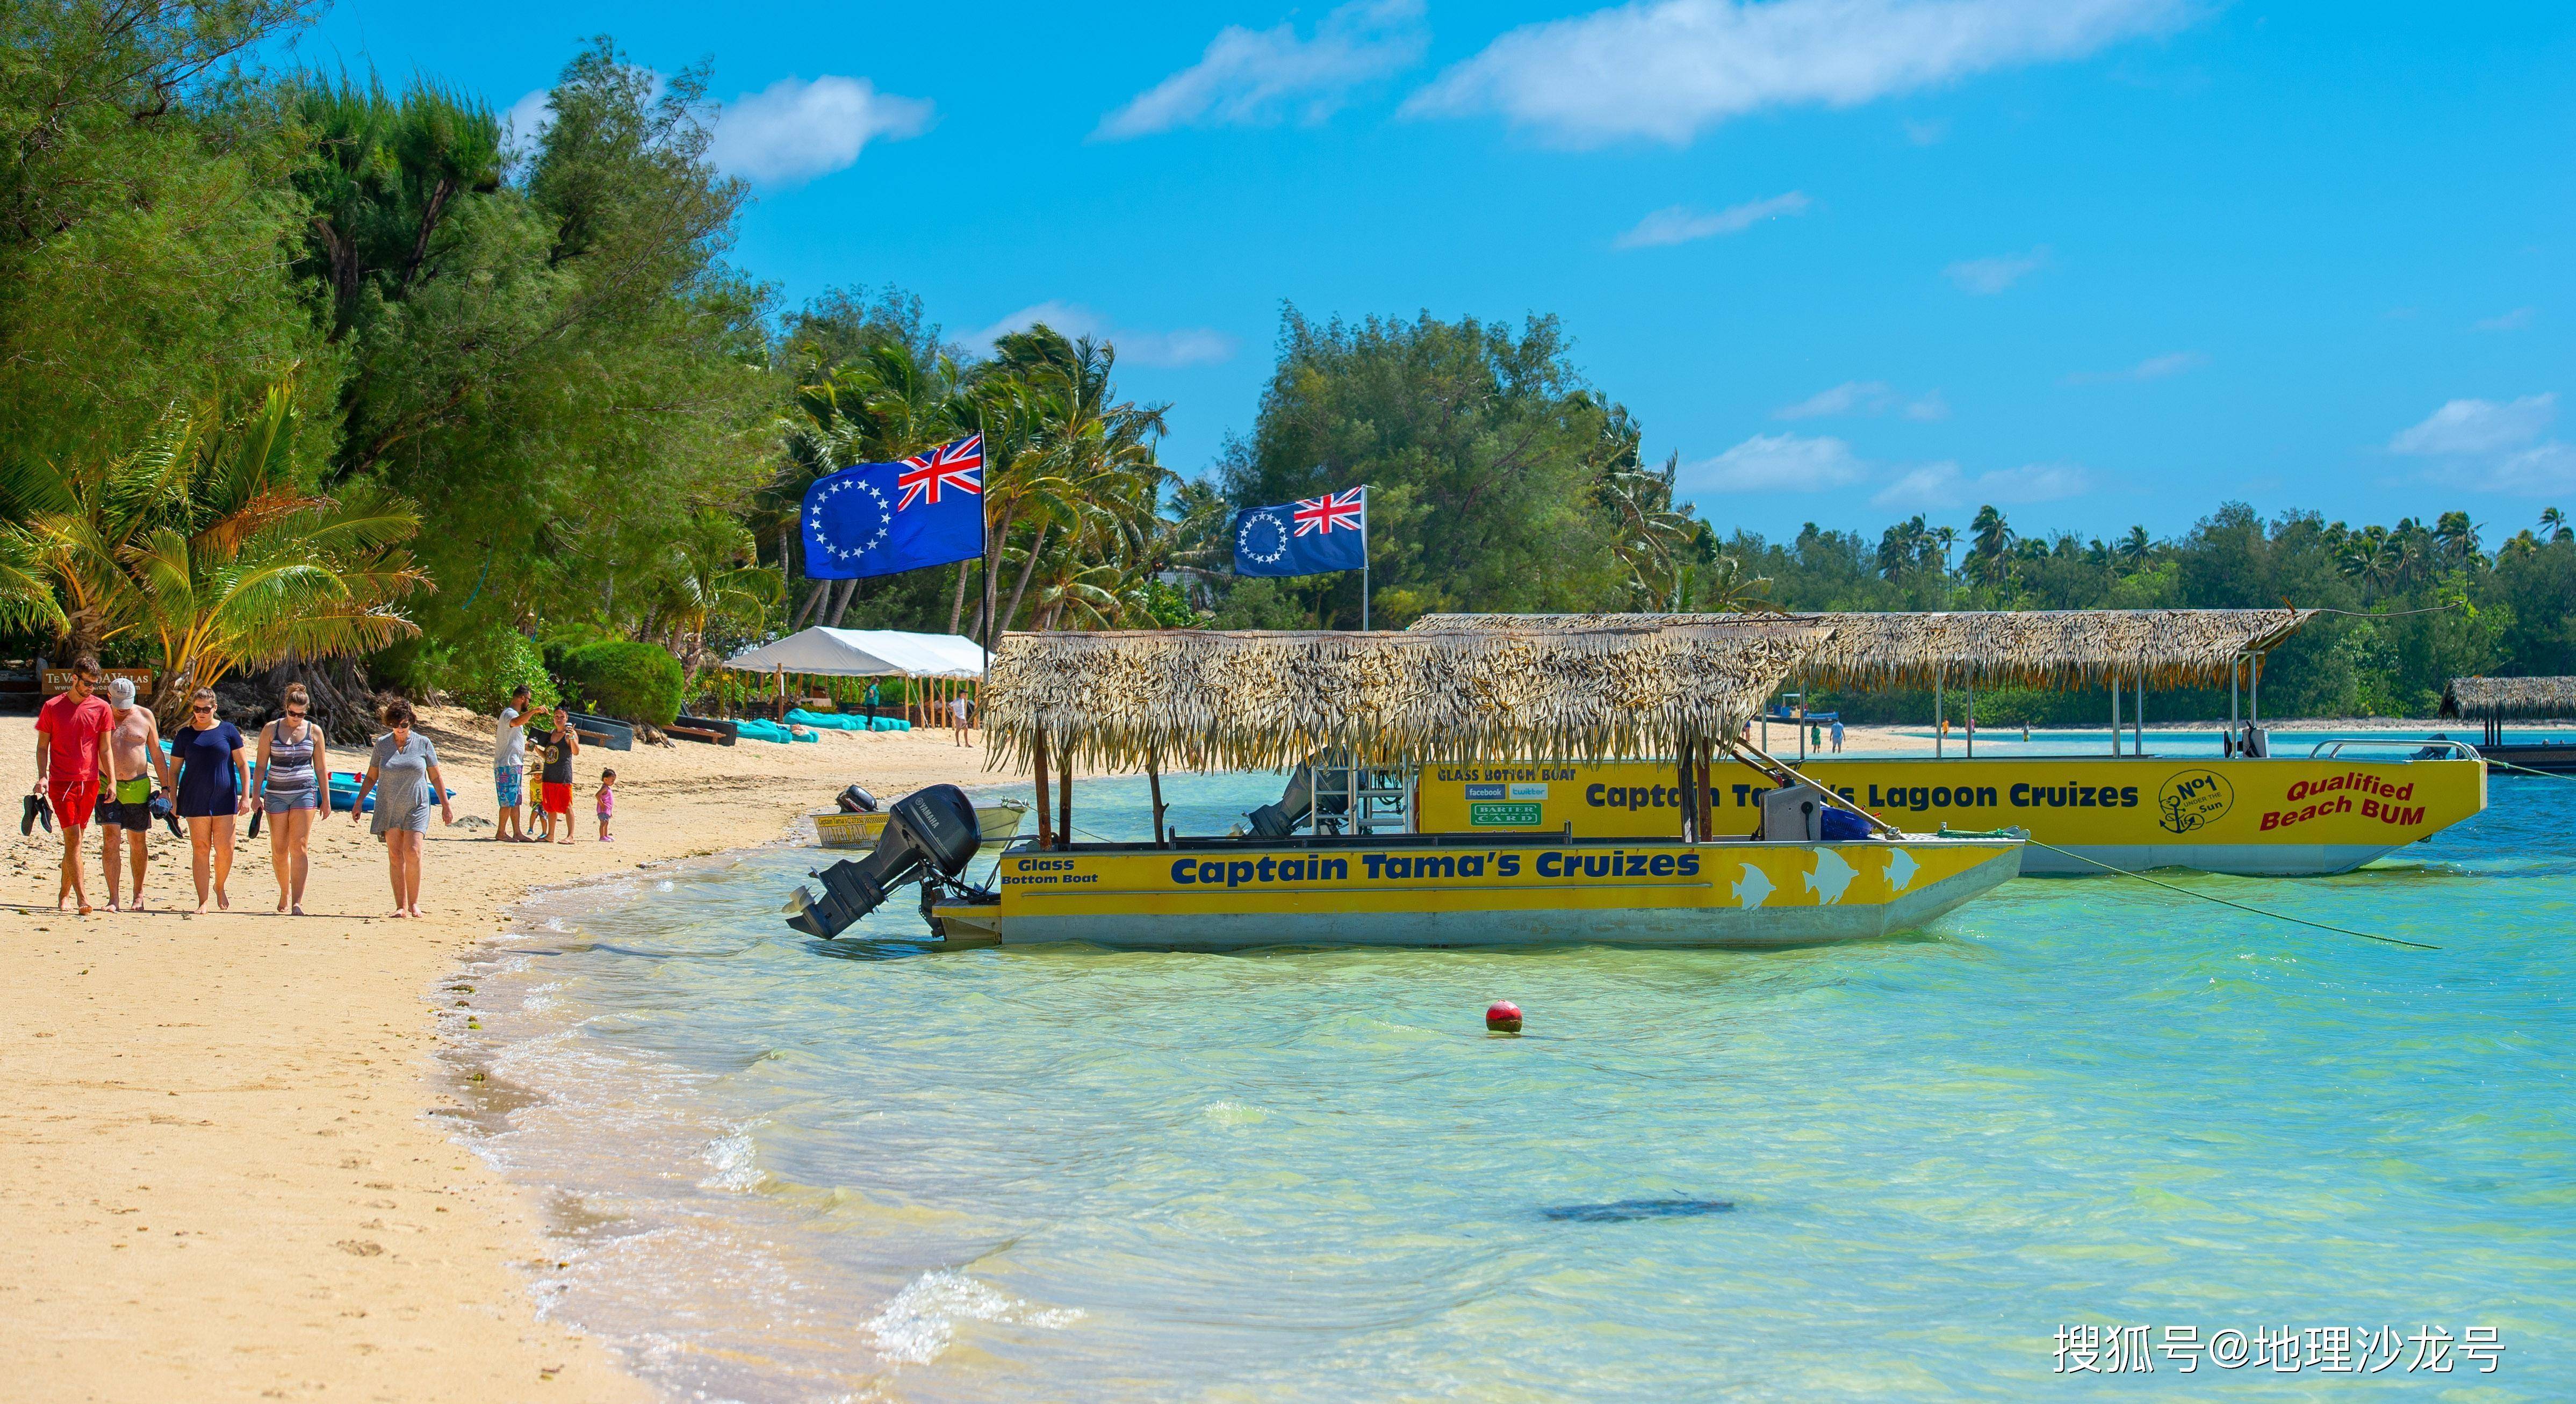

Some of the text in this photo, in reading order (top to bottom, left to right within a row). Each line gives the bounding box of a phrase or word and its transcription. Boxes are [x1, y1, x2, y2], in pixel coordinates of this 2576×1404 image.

[1437, 769, 1575, 781] GLASS BOTTOM BOAT
[1469, 788, 1501, 796] facebook
[2287, 772, 2414, 801] Qualified
[1868, 784, 1997, 811] Lagoon
[2009, 781, 2138, 808] Cruizes
[2183, 791, 2222, 807] UNDER THE
[2199, 801, 2223, 813] Sun
[2260, 795, 2426, 831] Beach BUM
[818, 817, 833, 826] Captain
[919, 802, 939, 829] YAMAHA
[819, 825, 850, 842] WATER
[1018, 859, 1074, 872] Glass
[1171, 851, 1700, 887] Captain Tama's Cruizes
[1002, 873, 1098, 884] Bottom Boat
